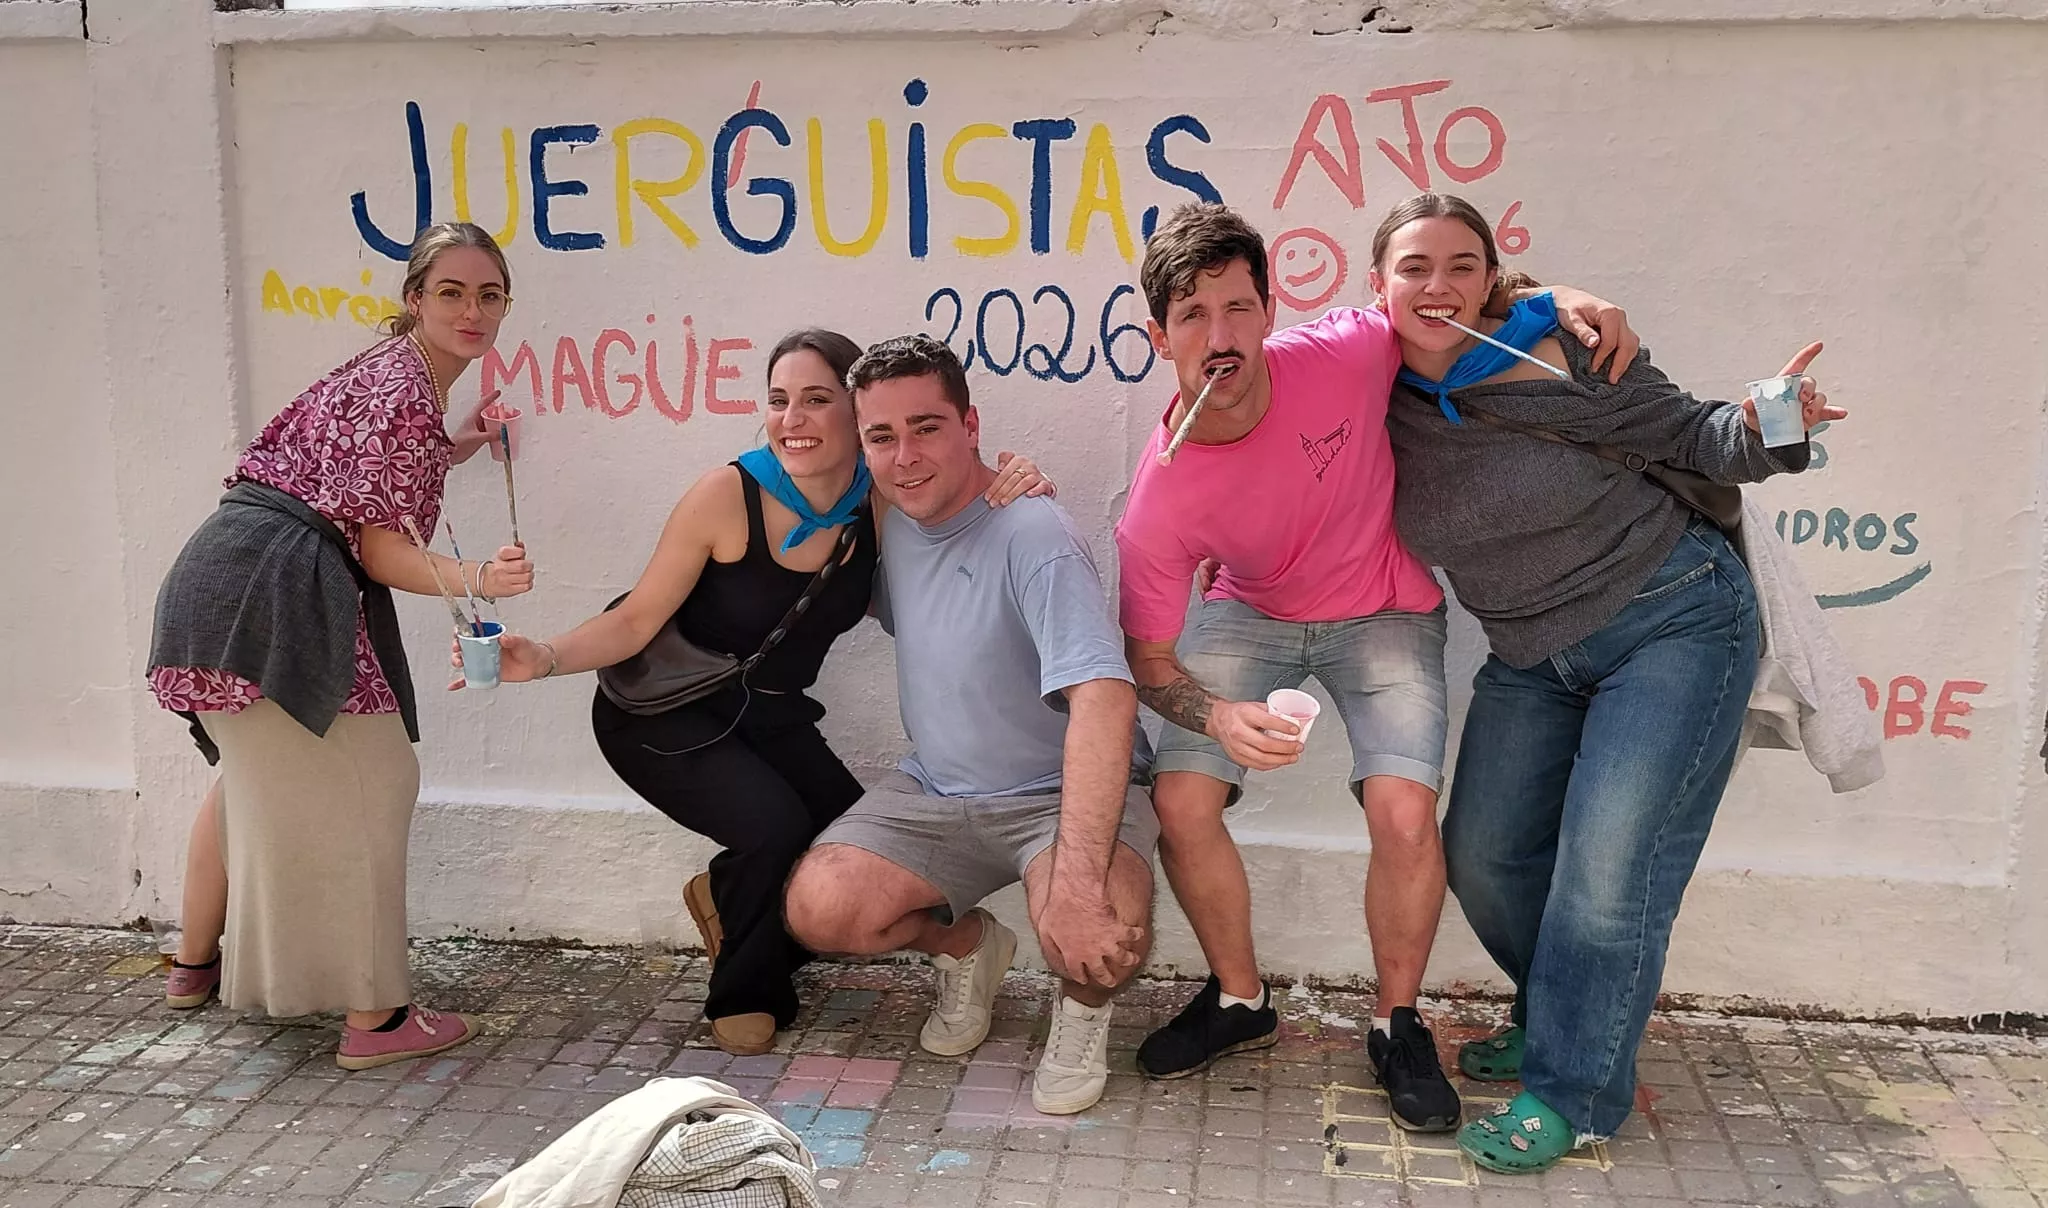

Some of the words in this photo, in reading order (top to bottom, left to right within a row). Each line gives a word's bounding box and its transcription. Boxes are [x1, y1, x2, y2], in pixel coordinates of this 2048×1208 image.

[1272, 79, 1507, 210] AJO
[480, 313, 759, 425] MAGÜE
[925, 284, 1156, 384] 2026
